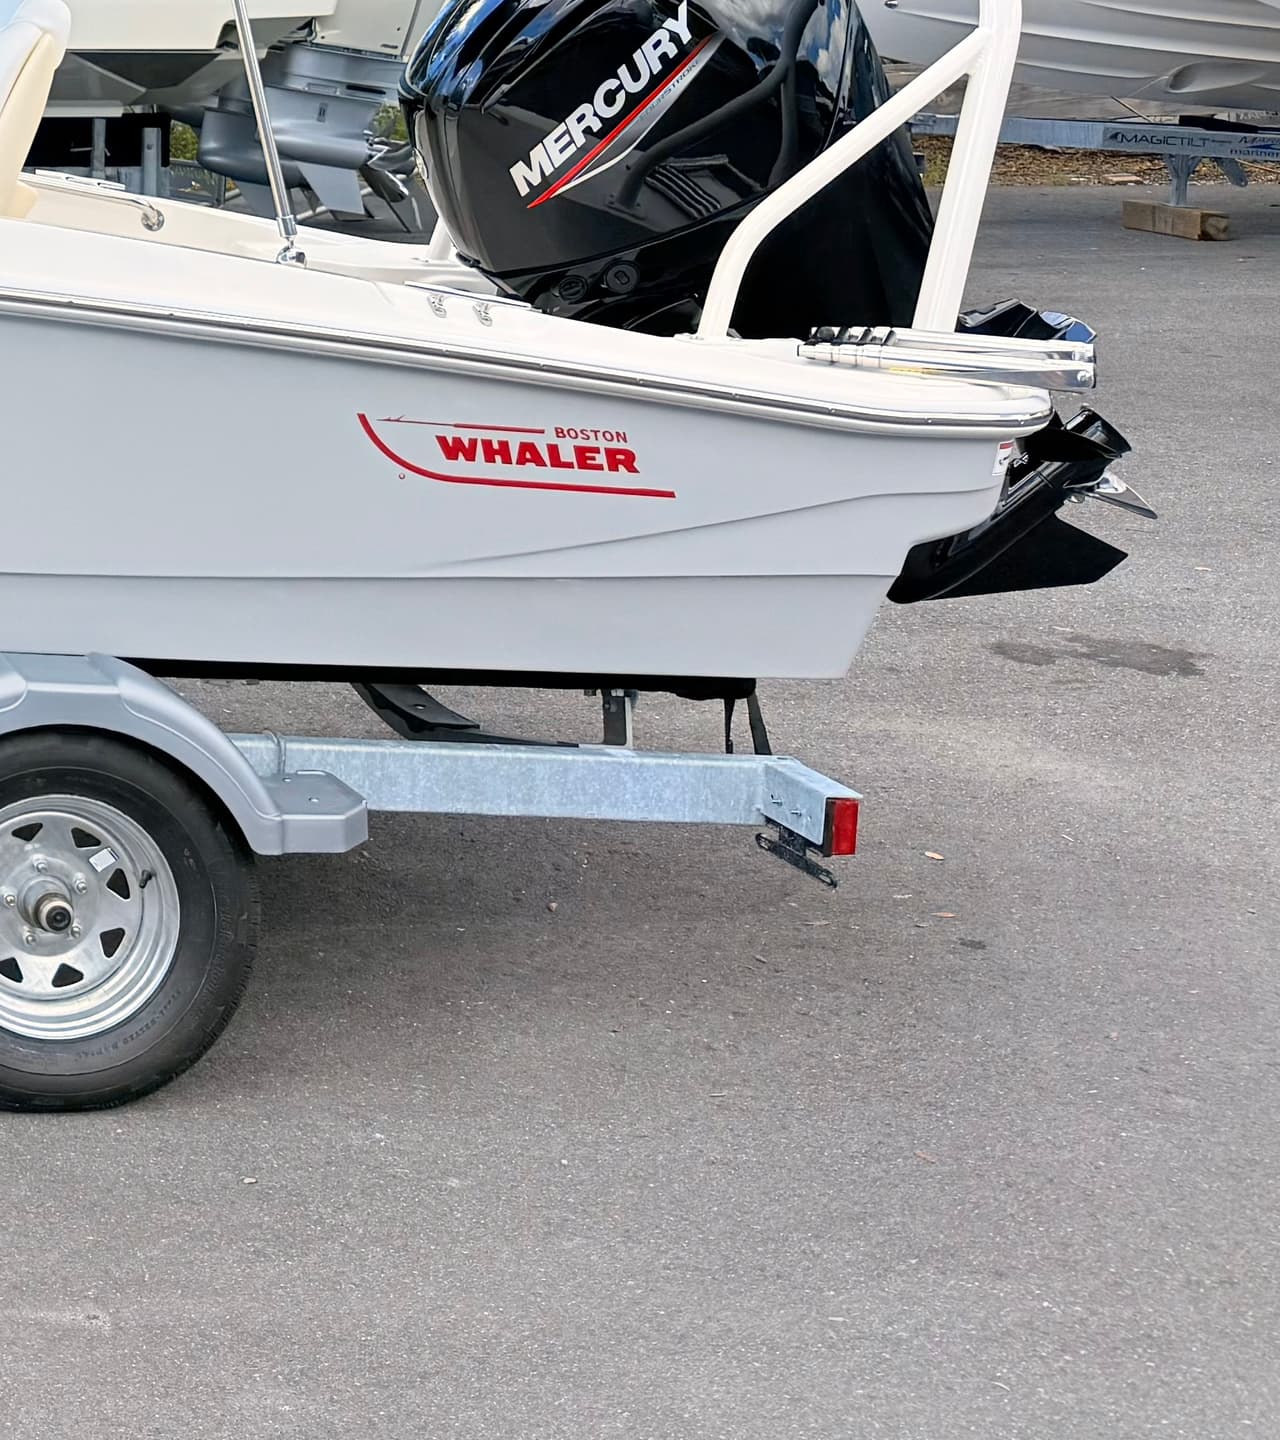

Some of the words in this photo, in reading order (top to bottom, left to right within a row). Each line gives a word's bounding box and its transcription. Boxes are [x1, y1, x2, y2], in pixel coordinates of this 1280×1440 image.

[1120, 132, 1210, 148] MAGICTILT
[554, 426, 628, 444] BOSTON
[435, 434, 641, 474] WHALER
